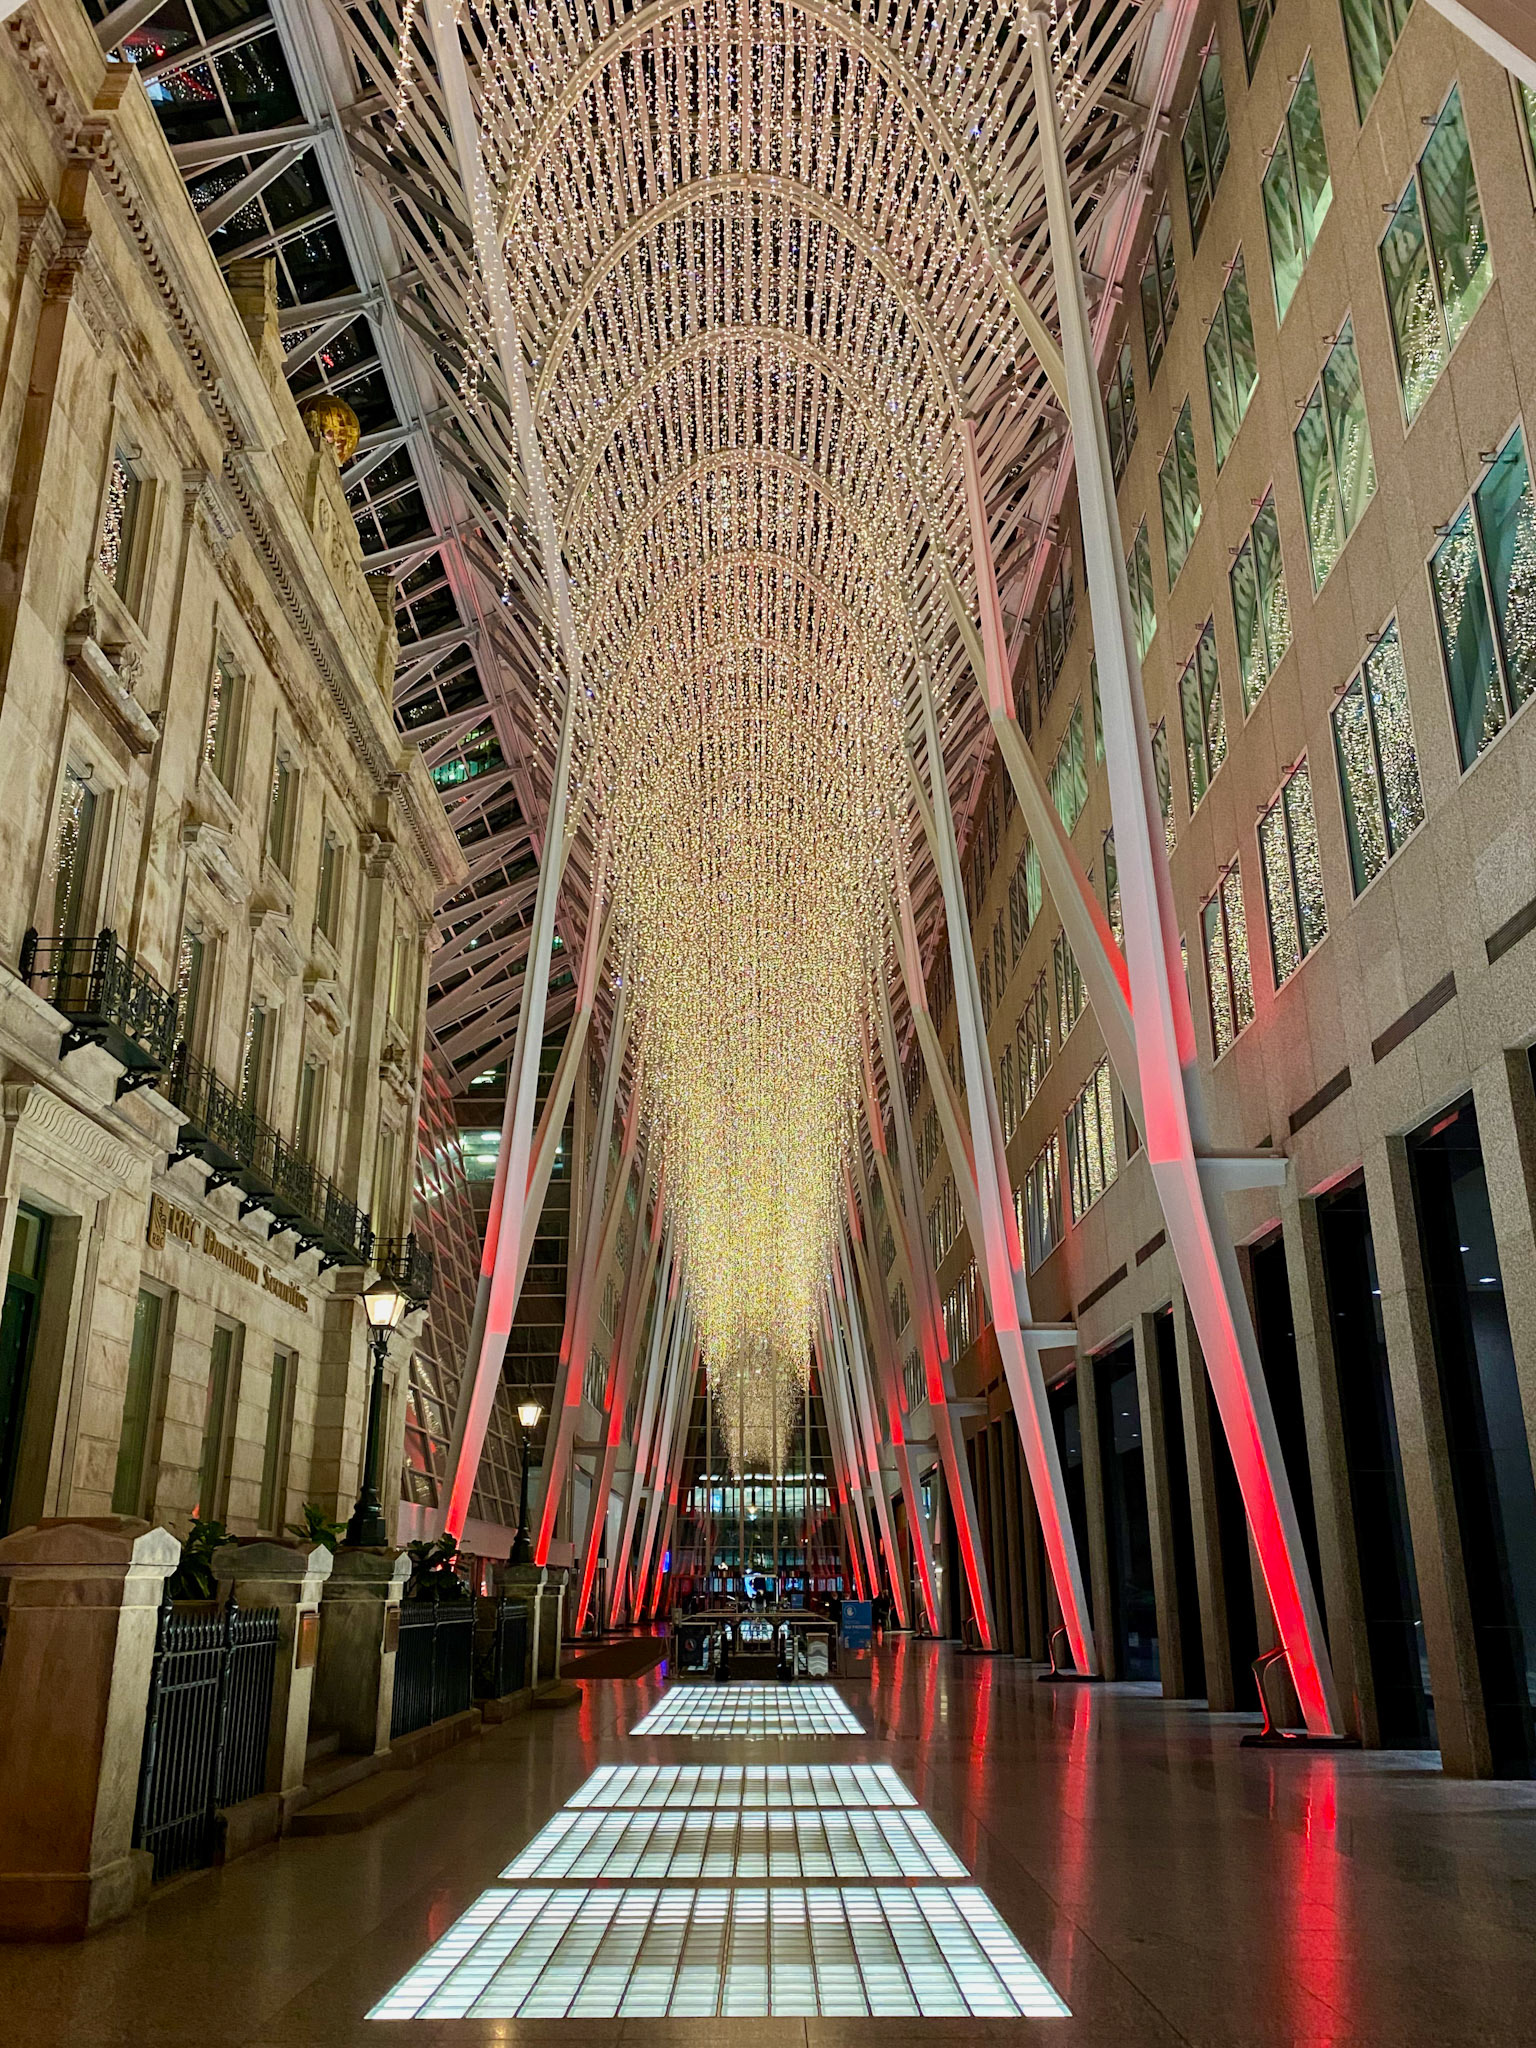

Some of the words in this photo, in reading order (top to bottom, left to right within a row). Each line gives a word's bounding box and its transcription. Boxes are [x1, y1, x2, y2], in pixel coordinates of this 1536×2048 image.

[152, 1232, 165, 1248] RBC
[169, 1204, 201, 1249] RBC
[203, 1226, 259, 1285] Dominion
[261, 1264, 309, 1313] Securities
